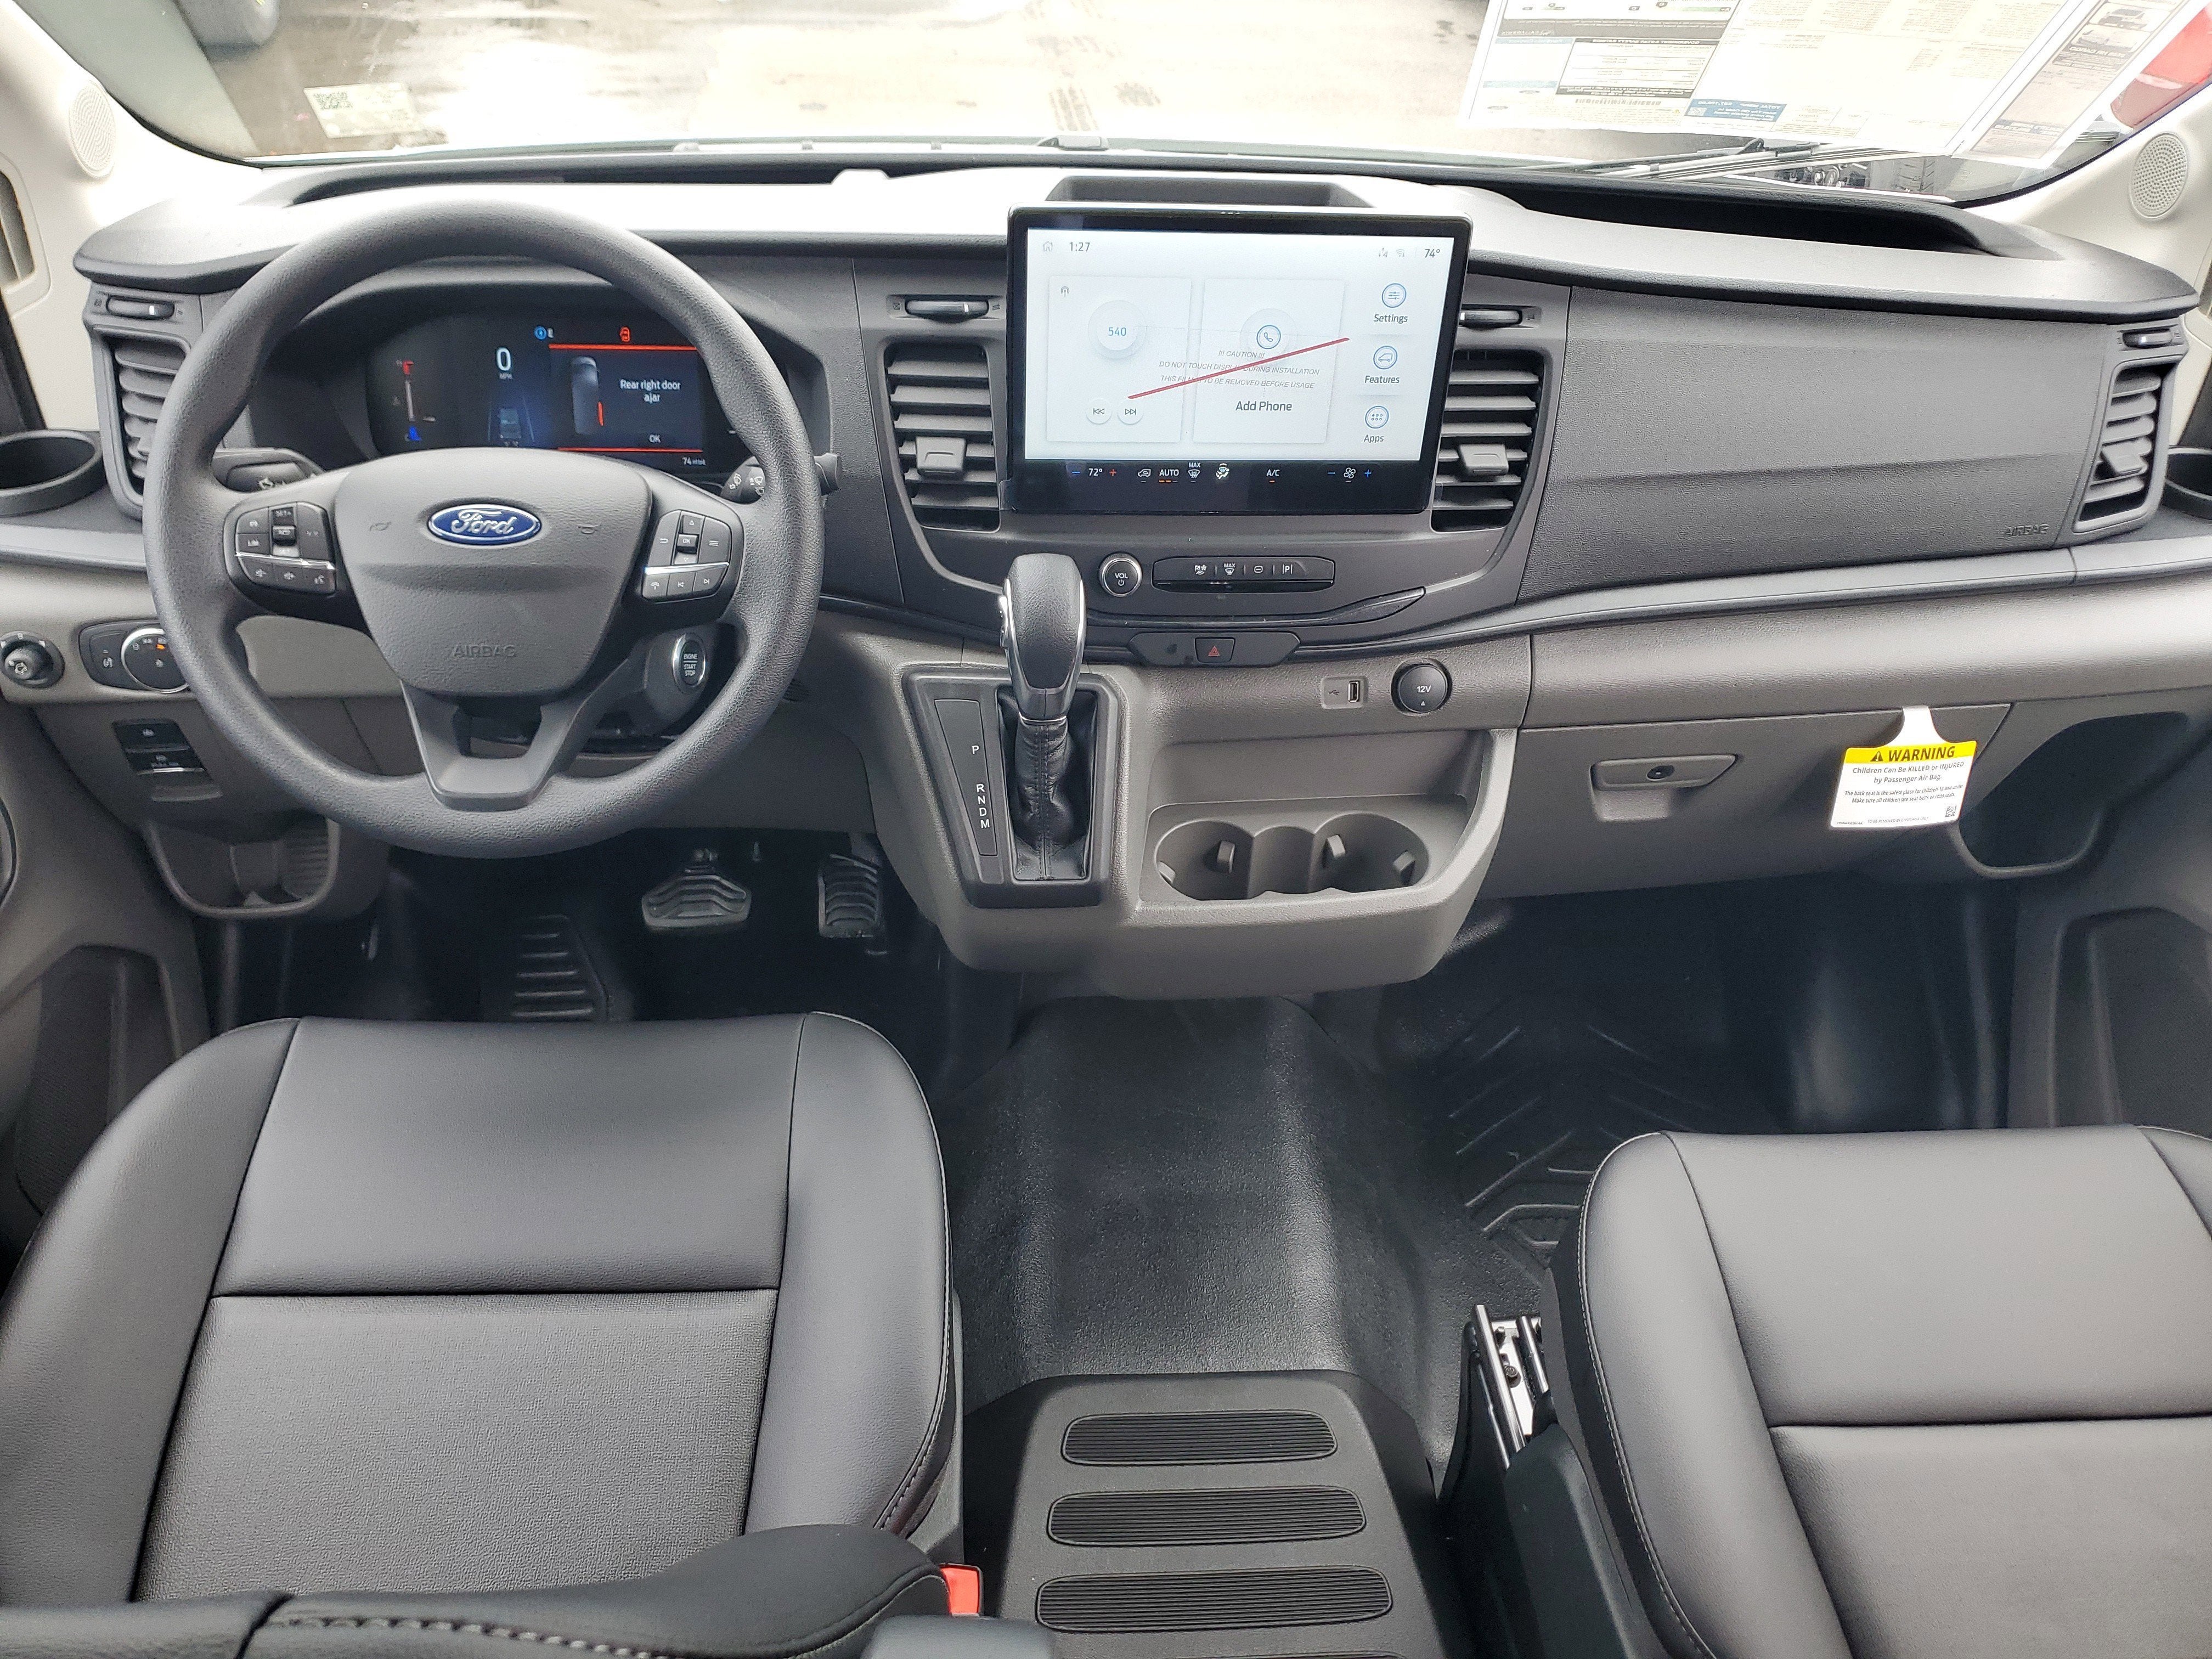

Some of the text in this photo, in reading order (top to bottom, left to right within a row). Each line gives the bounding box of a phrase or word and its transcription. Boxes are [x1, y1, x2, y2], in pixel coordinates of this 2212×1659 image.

[1069, 241, 1090, 252] 1:27
[1424, 248, 1441, 258] 74°
[1373, 313, 1408, 325] Settings
[1108, 326, 1127, 337] 540
[496, 347, 511, 371] 0
[1272, 366, 1320, 375] INSTALLATION
[1364, 374, 1400, 384] Features
[620, 379, 681, 392] Rear right door
[644, 392, 661, 403] ajar
[1235, 400, 1293, 412] Add Phone
[648, 434, 661, 443] OK
[1363, 434, 1384, 444] Apps
[681, 456, 692, 465] 74
[1088, 467, 1103, 477] 72°
[1159, 469, 1180, 477] AUTO
[451, 509, 518, 535] Ford
[2006, 523, 2050, 537] AIRBAG
[452, 644, 517, 658] AIRBAG
[1417, 685, 1431, 693] 12V
[972, 744, 979, 754] P
[1888, 746, 1956, 762] WARNING
[1940, 761, 1965, 770] INJURED
[1884, 775, 1917, 783] Passenger
[976, 783, 985, 793] R
[978, 795, 986, 805] N
[979, 808, 987, 816] D
[980, 819, 990, 828] M
